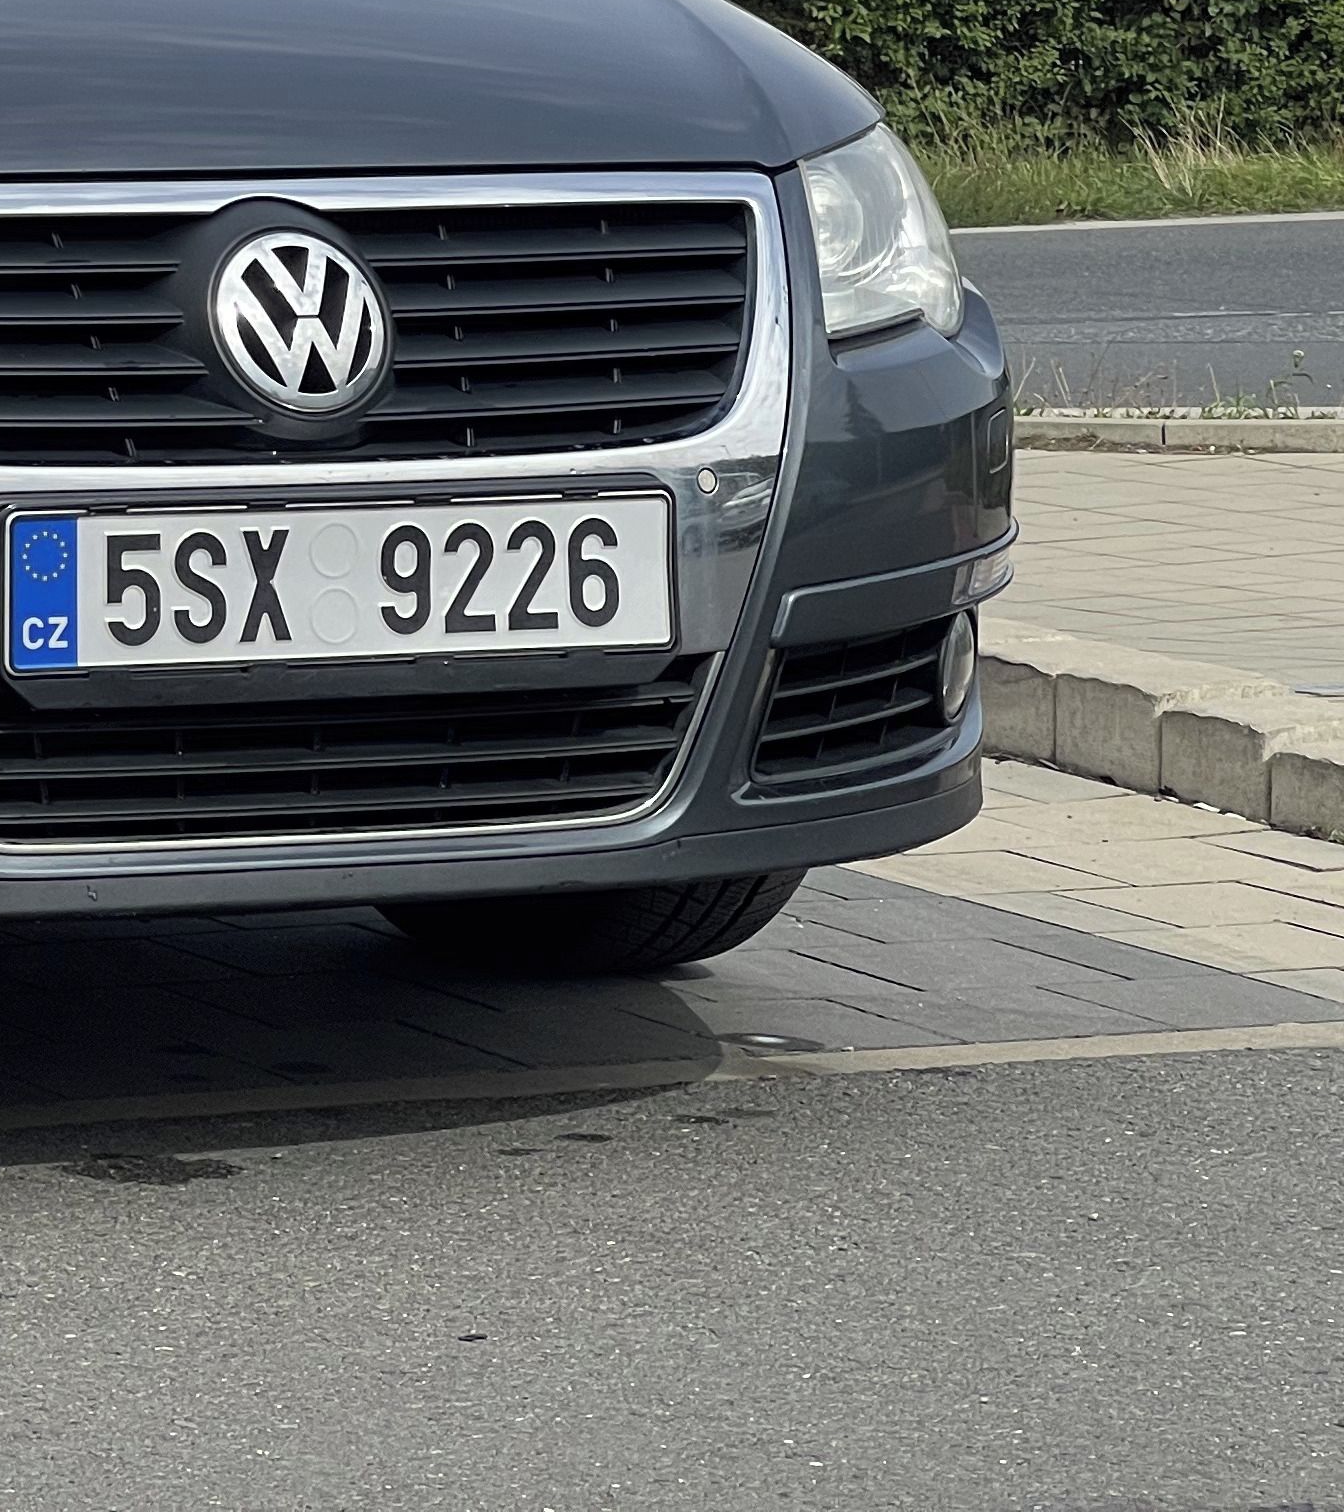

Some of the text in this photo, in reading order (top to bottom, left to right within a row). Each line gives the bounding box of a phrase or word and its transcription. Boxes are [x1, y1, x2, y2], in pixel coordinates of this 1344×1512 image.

[105, 516, 621, 647] 5SX 9226
[22, 616, 69, 650] CZ
